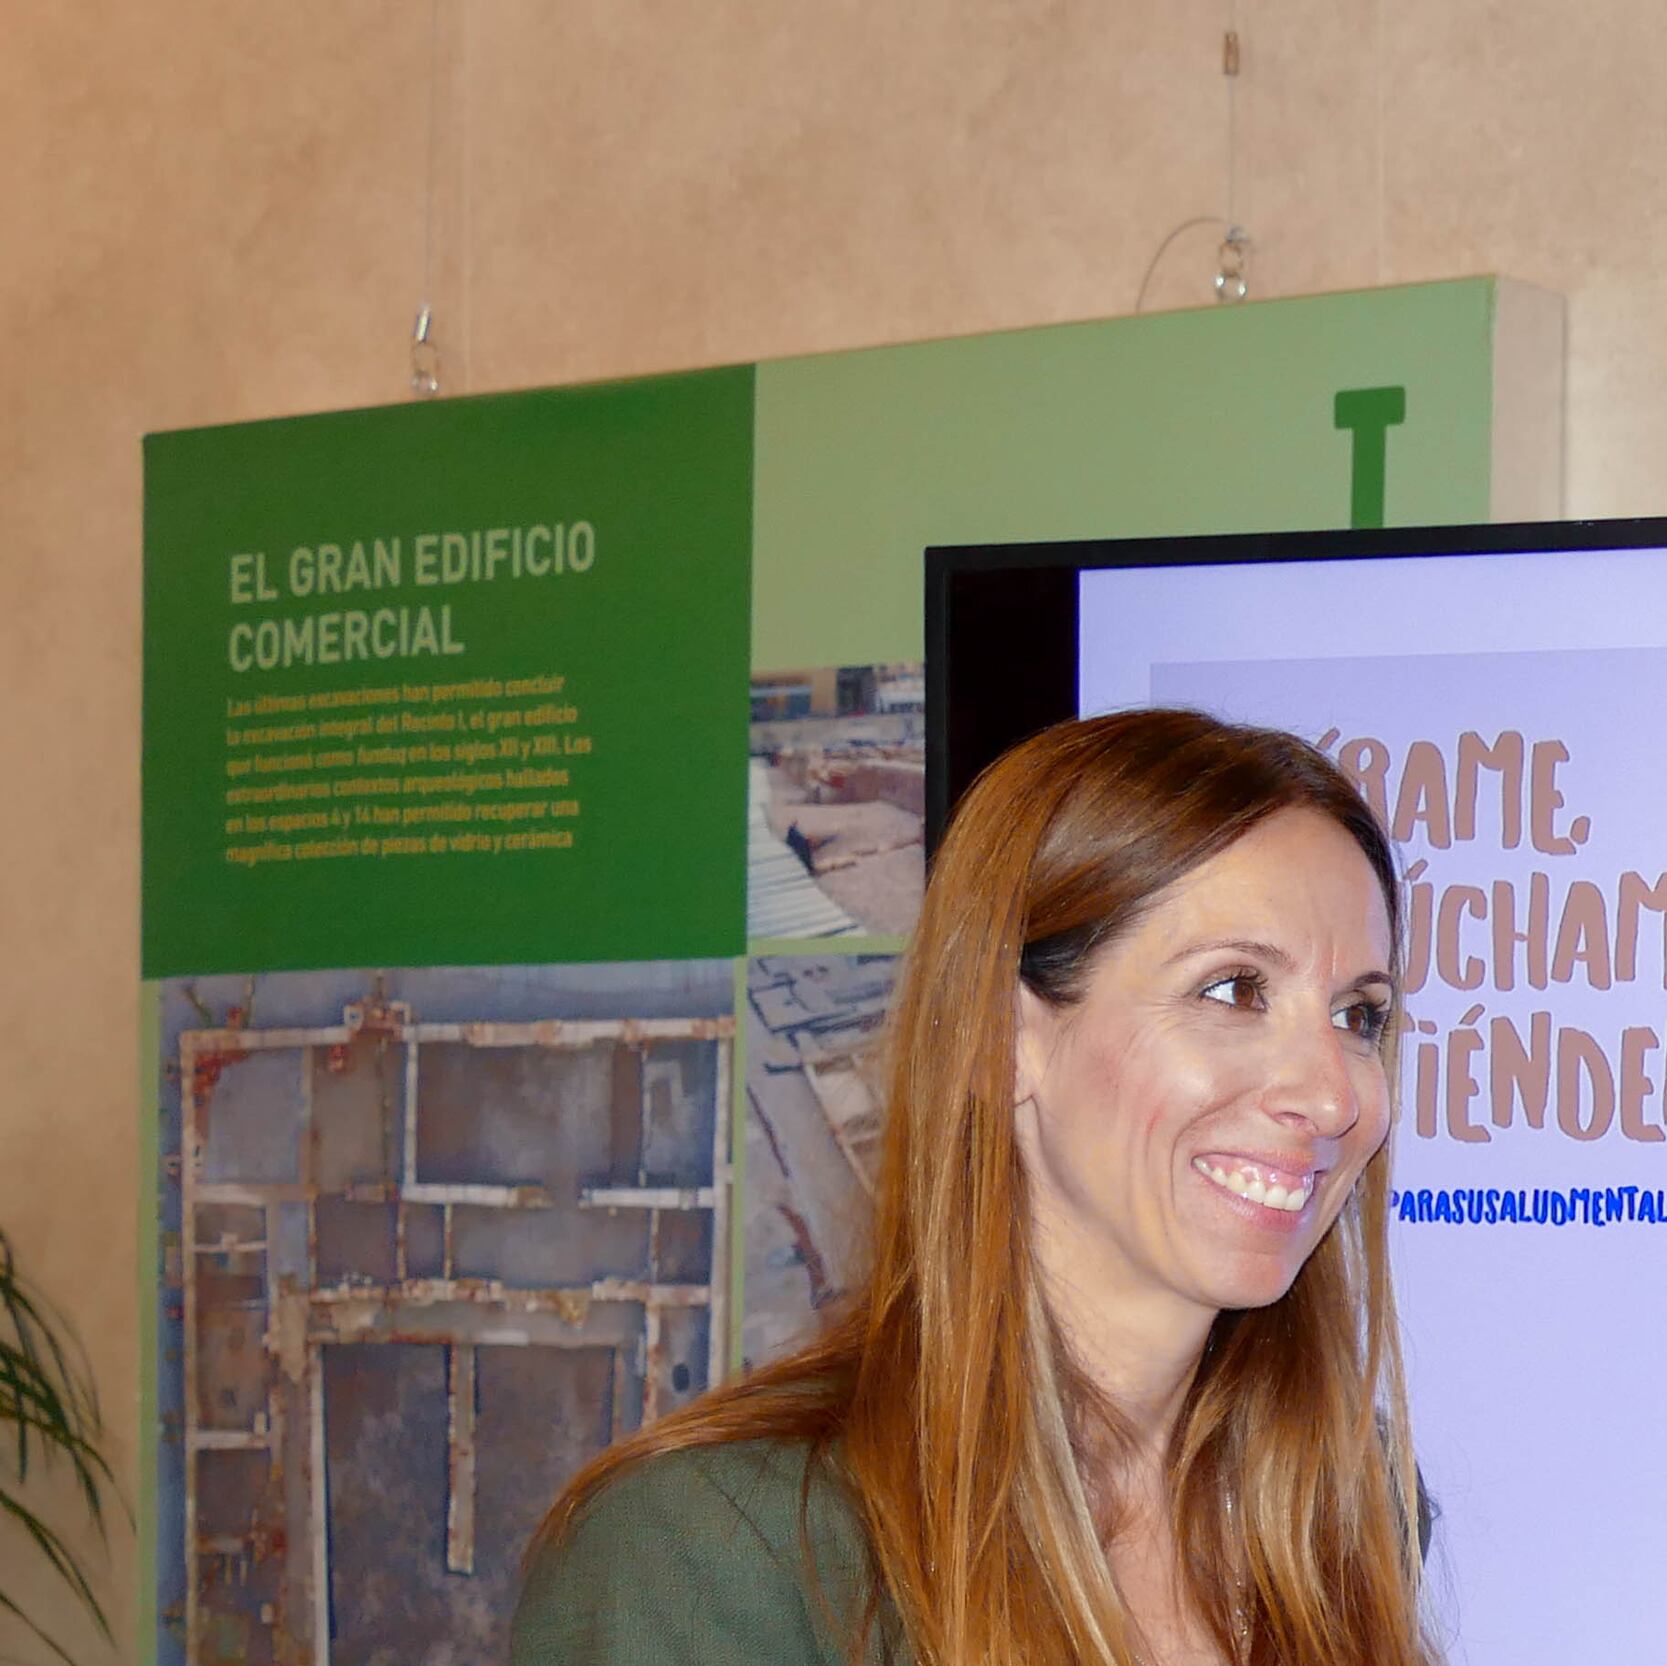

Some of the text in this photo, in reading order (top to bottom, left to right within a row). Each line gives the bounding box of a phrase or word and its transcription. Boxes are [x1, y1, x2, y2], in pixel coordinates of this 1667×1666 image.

[230, 520, 596, 603] EL GRAN EDIFICIO
[229, 604, 465, 672] COMERCIAL
[1318, 728, 1592, 857] RAME,
